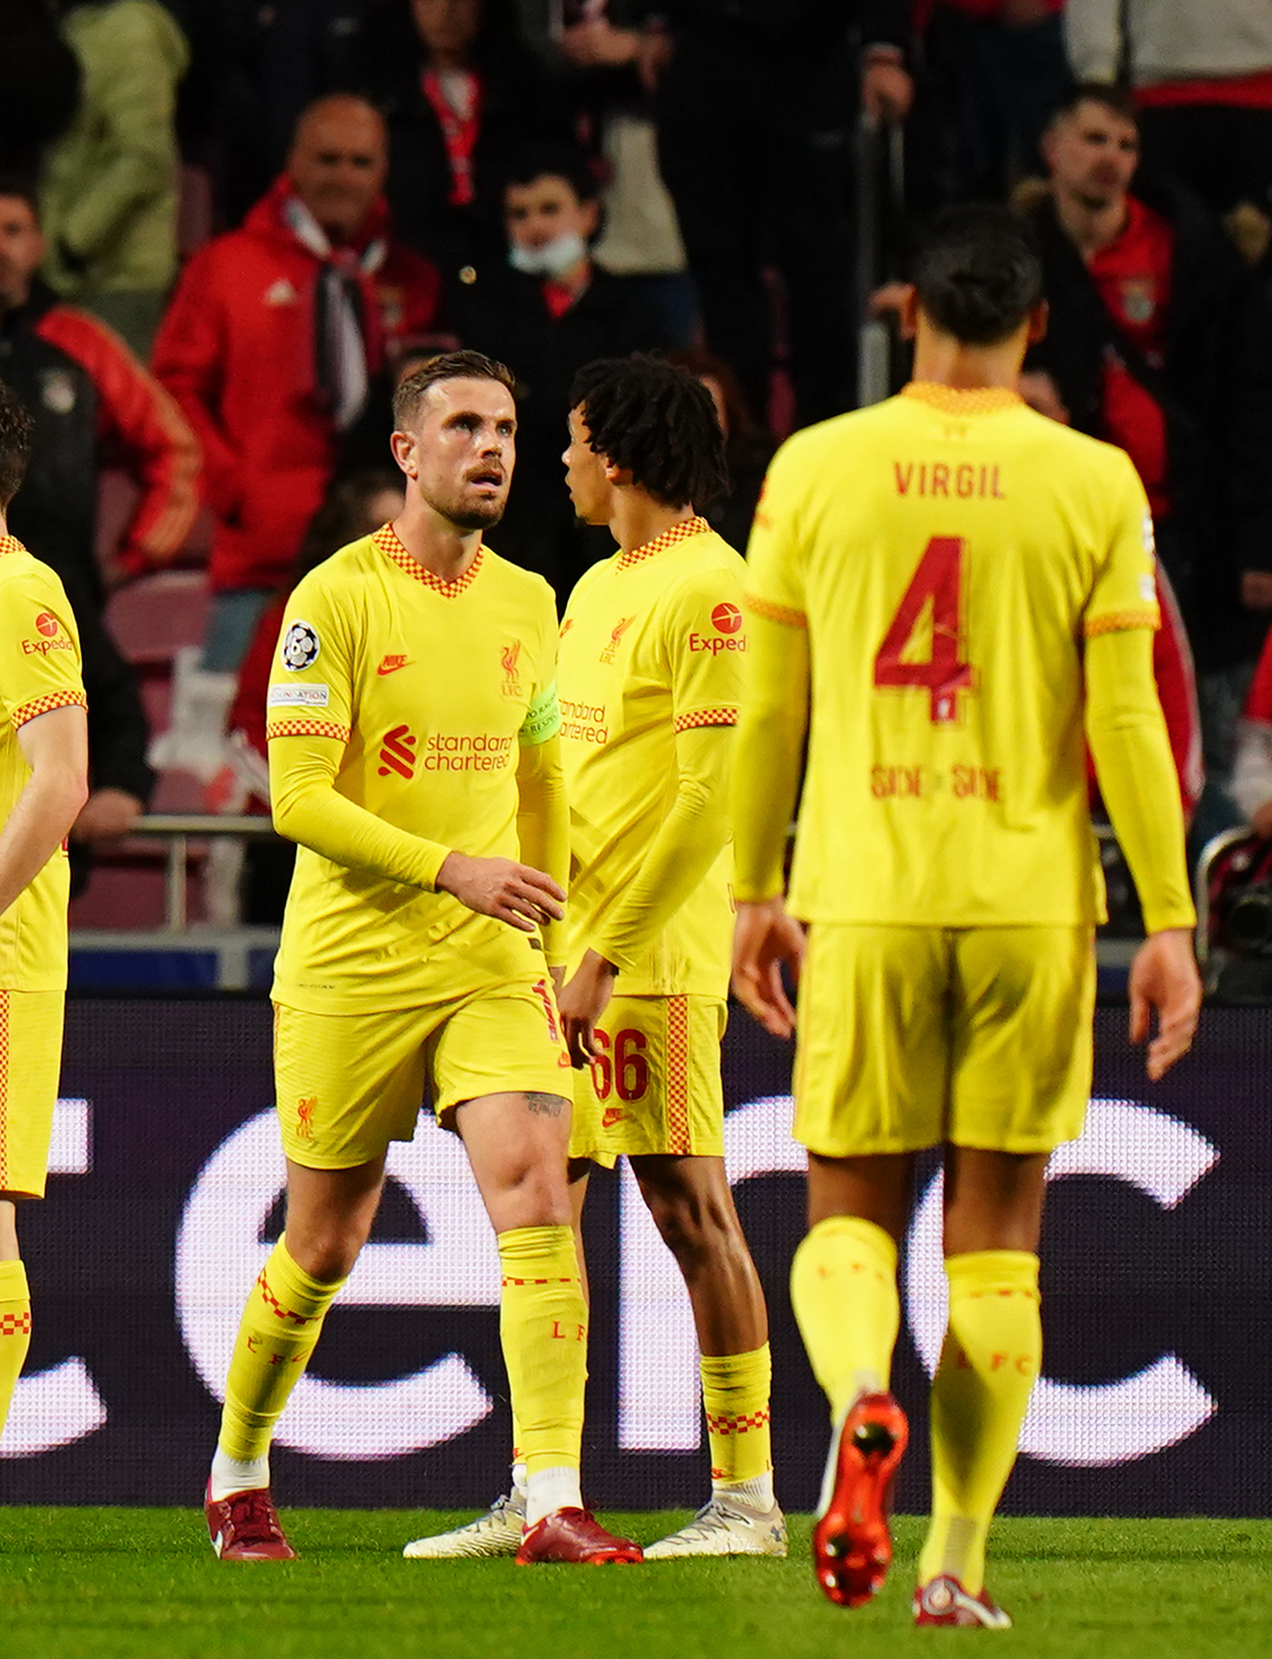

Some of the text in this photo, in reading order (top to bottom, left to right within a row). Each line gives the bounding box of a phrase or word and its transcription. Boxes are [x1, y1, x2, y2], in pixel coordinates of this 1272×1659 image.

[893, 461, 1007, 500] VIRGIL
[872, 535, 973, 722] 4
[589, 1028, 650, 1103] 66
